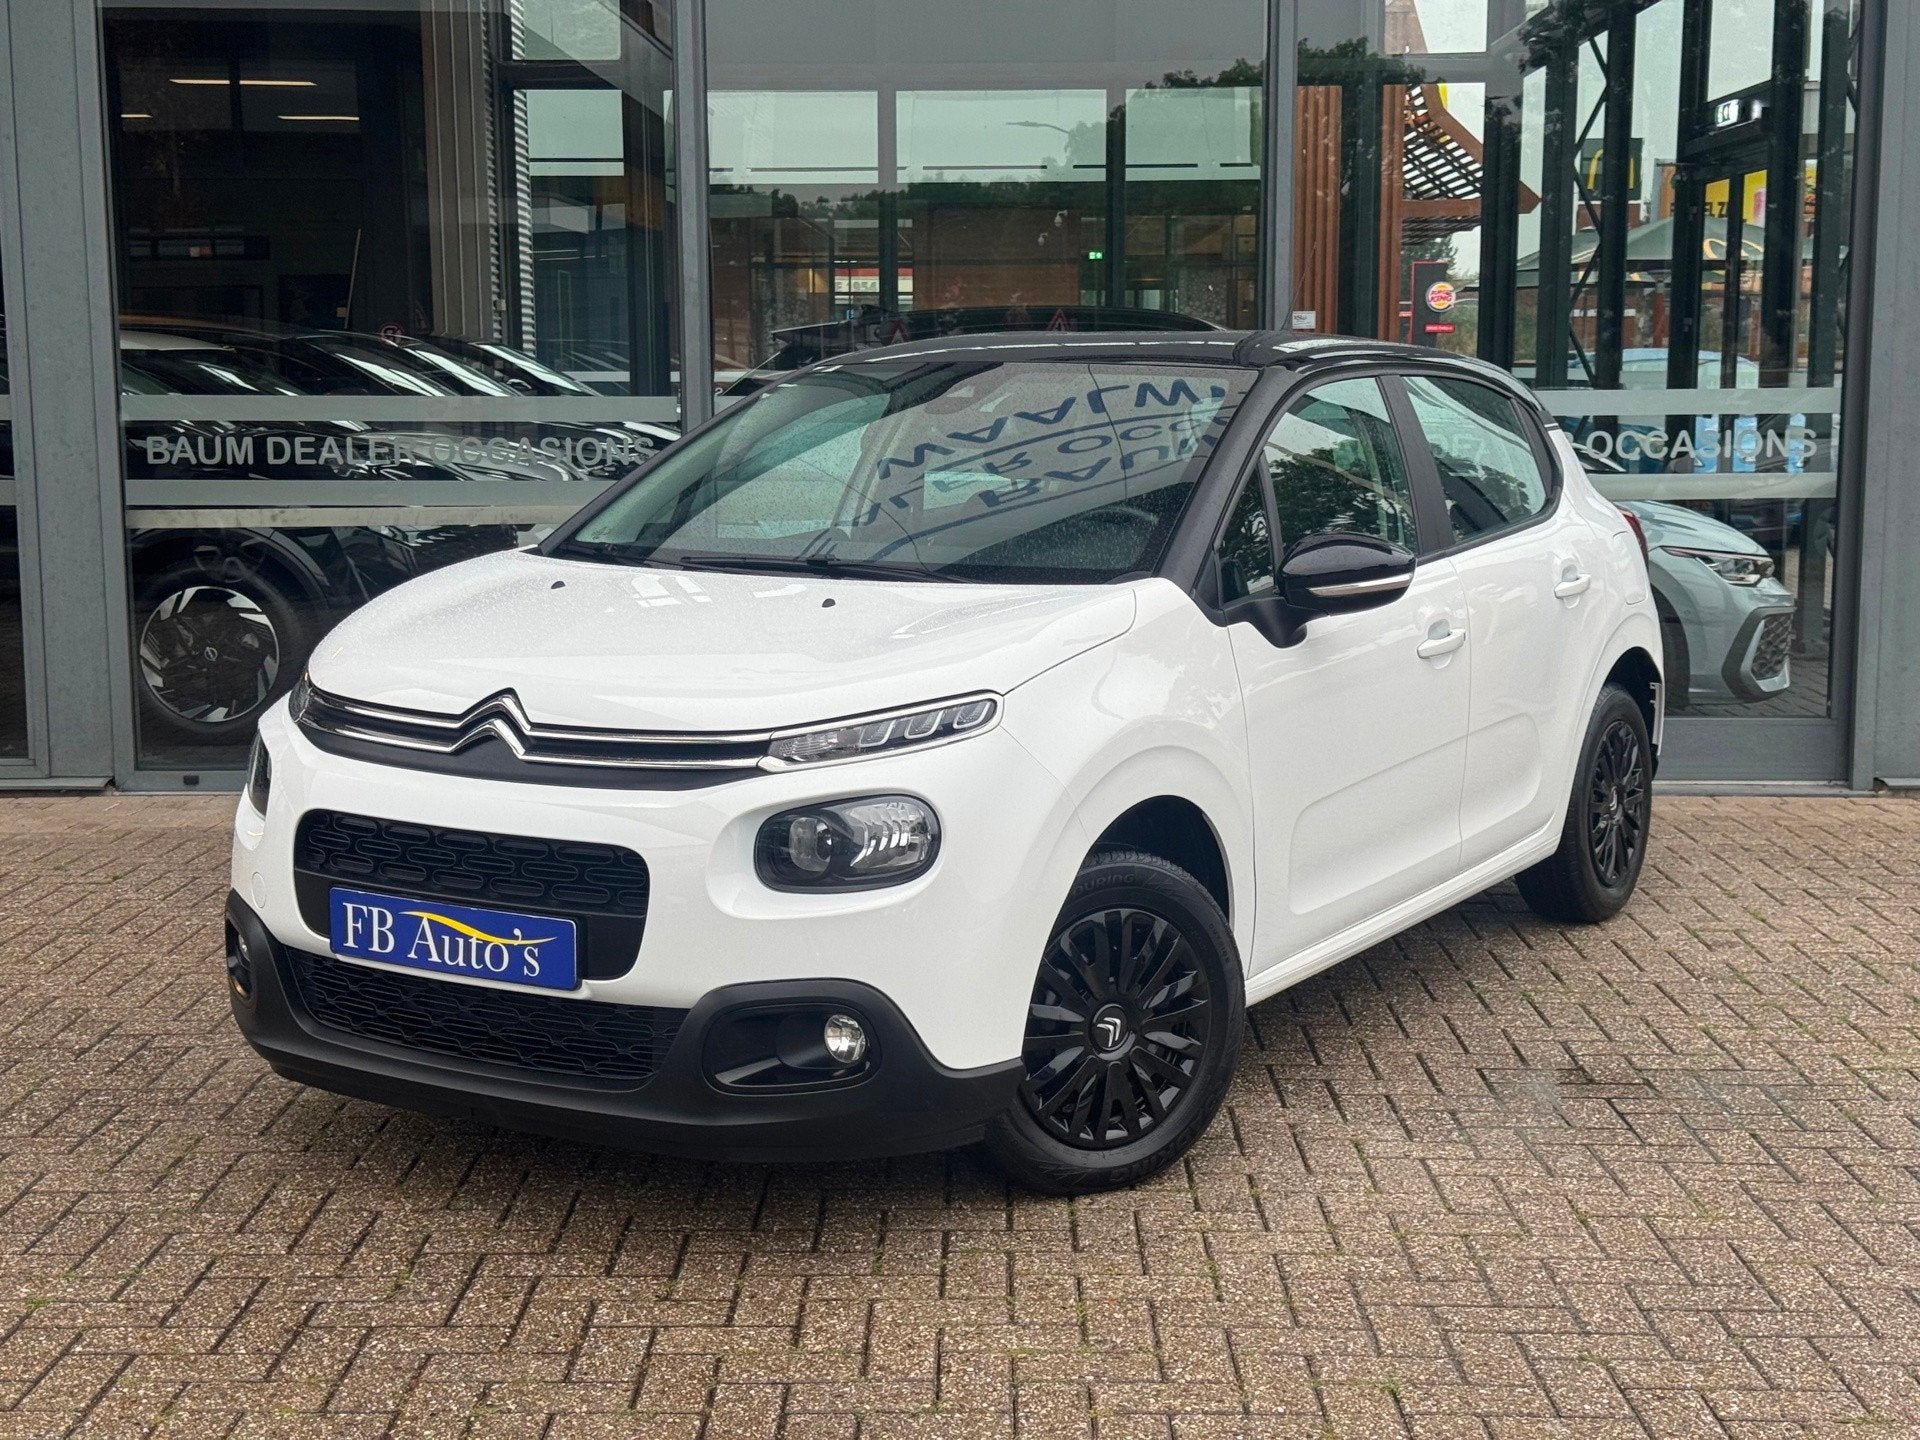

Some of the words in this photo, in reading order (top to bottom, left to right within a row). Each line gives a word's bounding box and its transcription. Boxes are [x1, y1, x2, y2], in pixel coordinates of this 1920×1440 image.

[146, 436, 254, 466] BAUM
[266, 436, 419, 466] DEALER
[429, 436, 654, 466] OCCASIONS
[1586, 429, 1817, 461] OCCASIONS
[343, 902, 395, 954] FB
[407, 914, 541, 977] Auto's
